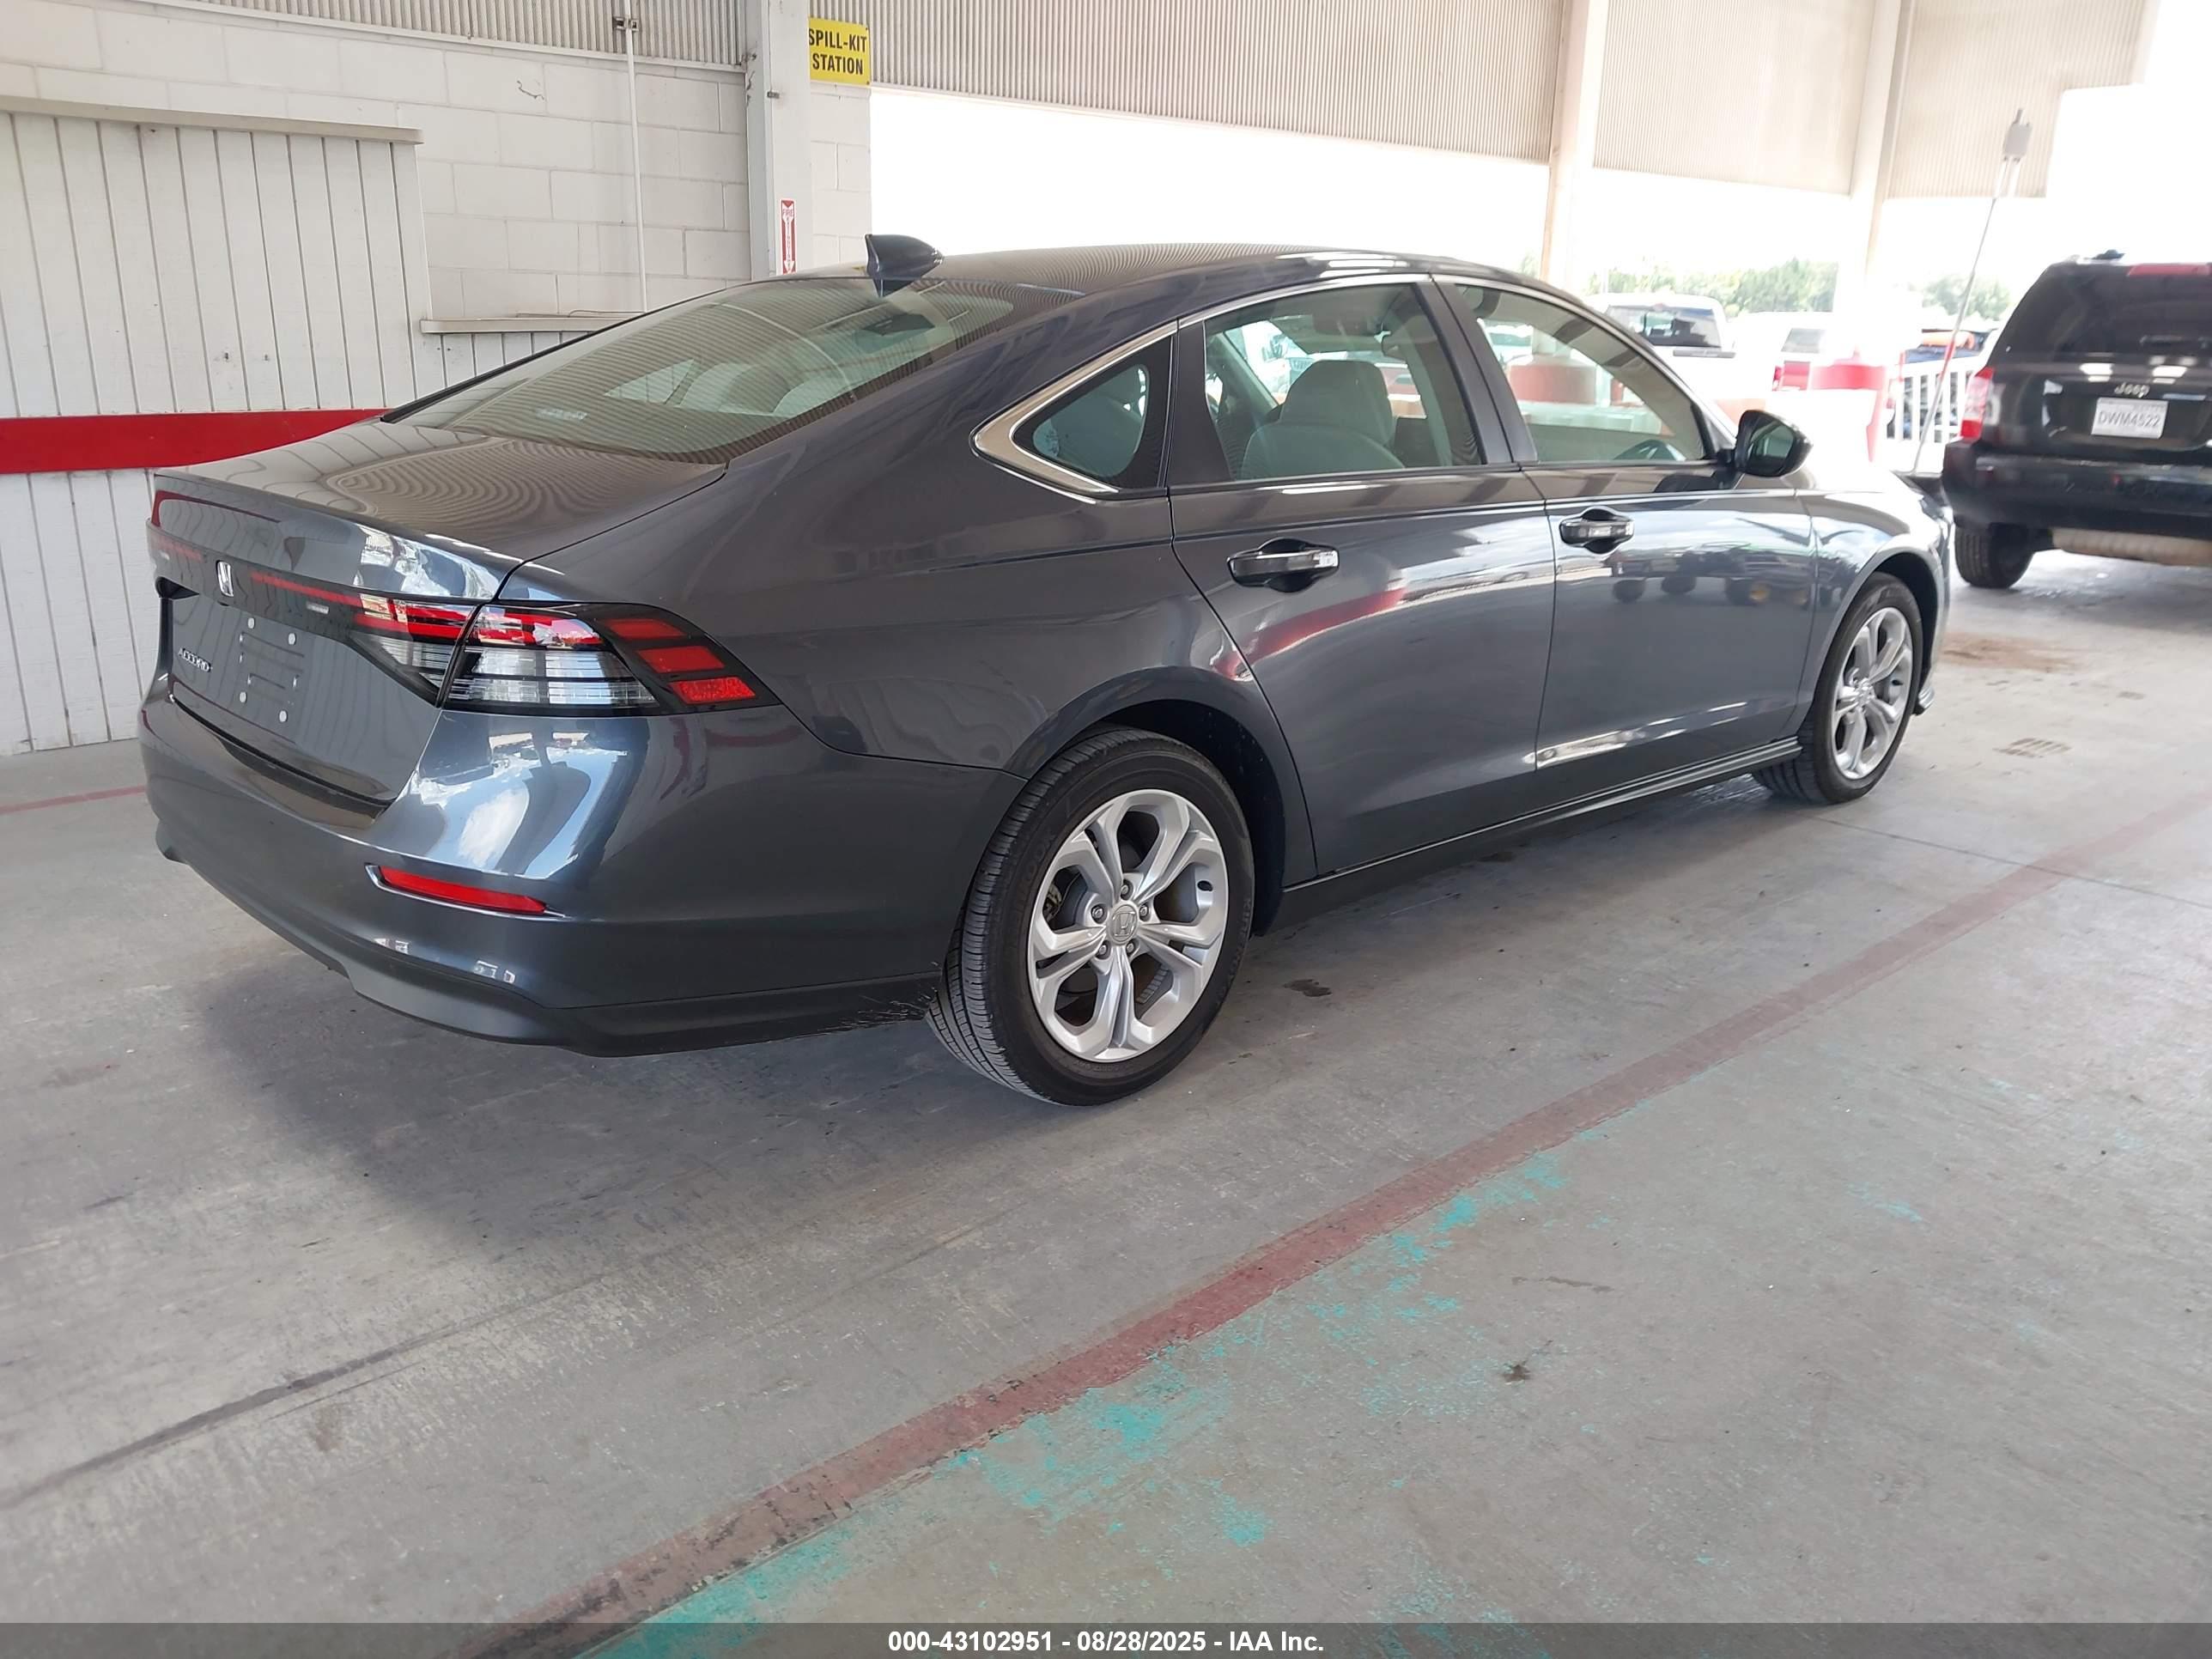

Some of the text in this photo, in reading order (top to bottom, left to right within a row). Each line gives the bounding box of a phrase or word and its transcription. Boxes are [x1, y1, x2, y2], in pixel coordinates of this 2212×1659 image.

[808, 27, 866, 53] SPILL-KIT
[812, 52, 863, 76] STATION
[177, 647, 210, 672] ACCORD
